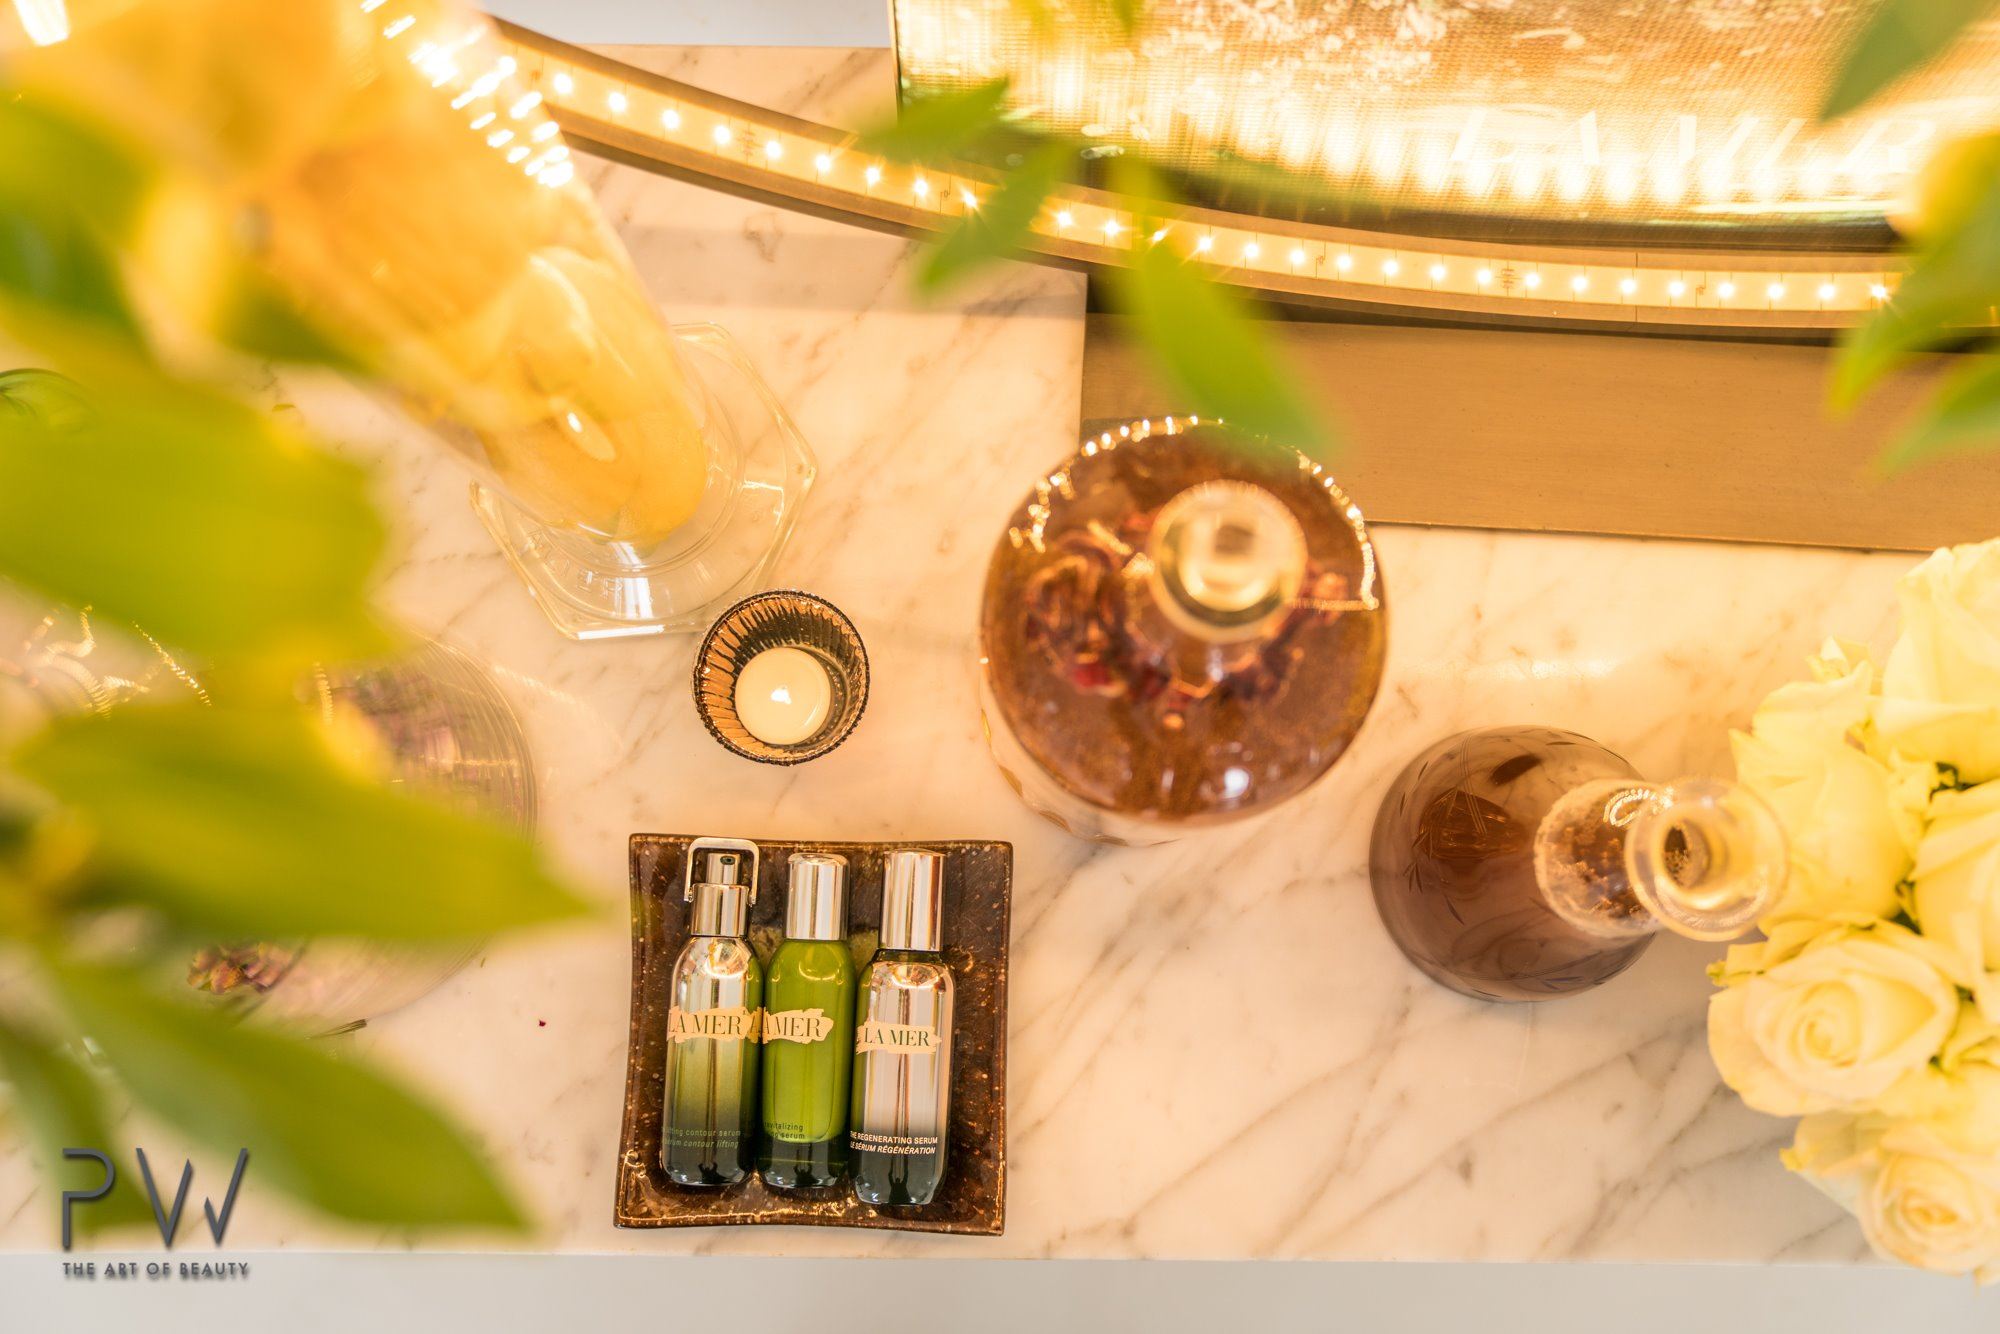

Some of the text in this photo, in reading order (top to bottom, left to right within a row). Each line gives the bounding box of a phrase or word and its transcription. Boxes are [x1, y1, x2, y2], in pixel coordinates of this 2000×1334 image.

[691, 1013, 743, 1036] MER
[773, 1015, 822, 1038] MER
[864, 1027, 930, 1047] LA MER
[764, 1121, 804, 1132] vitalizing
[685, 1129, 716, 1137] contour
[857, 1132, 913, 1144] REGENERATING
[914, 1136, 938, 1145] SERUM
[683, 1140, 714, 1148] contour
[716, 1140, 739, 1149] lifting
[877, 1144, 936, 1155] RÉGÉNÉRATION
